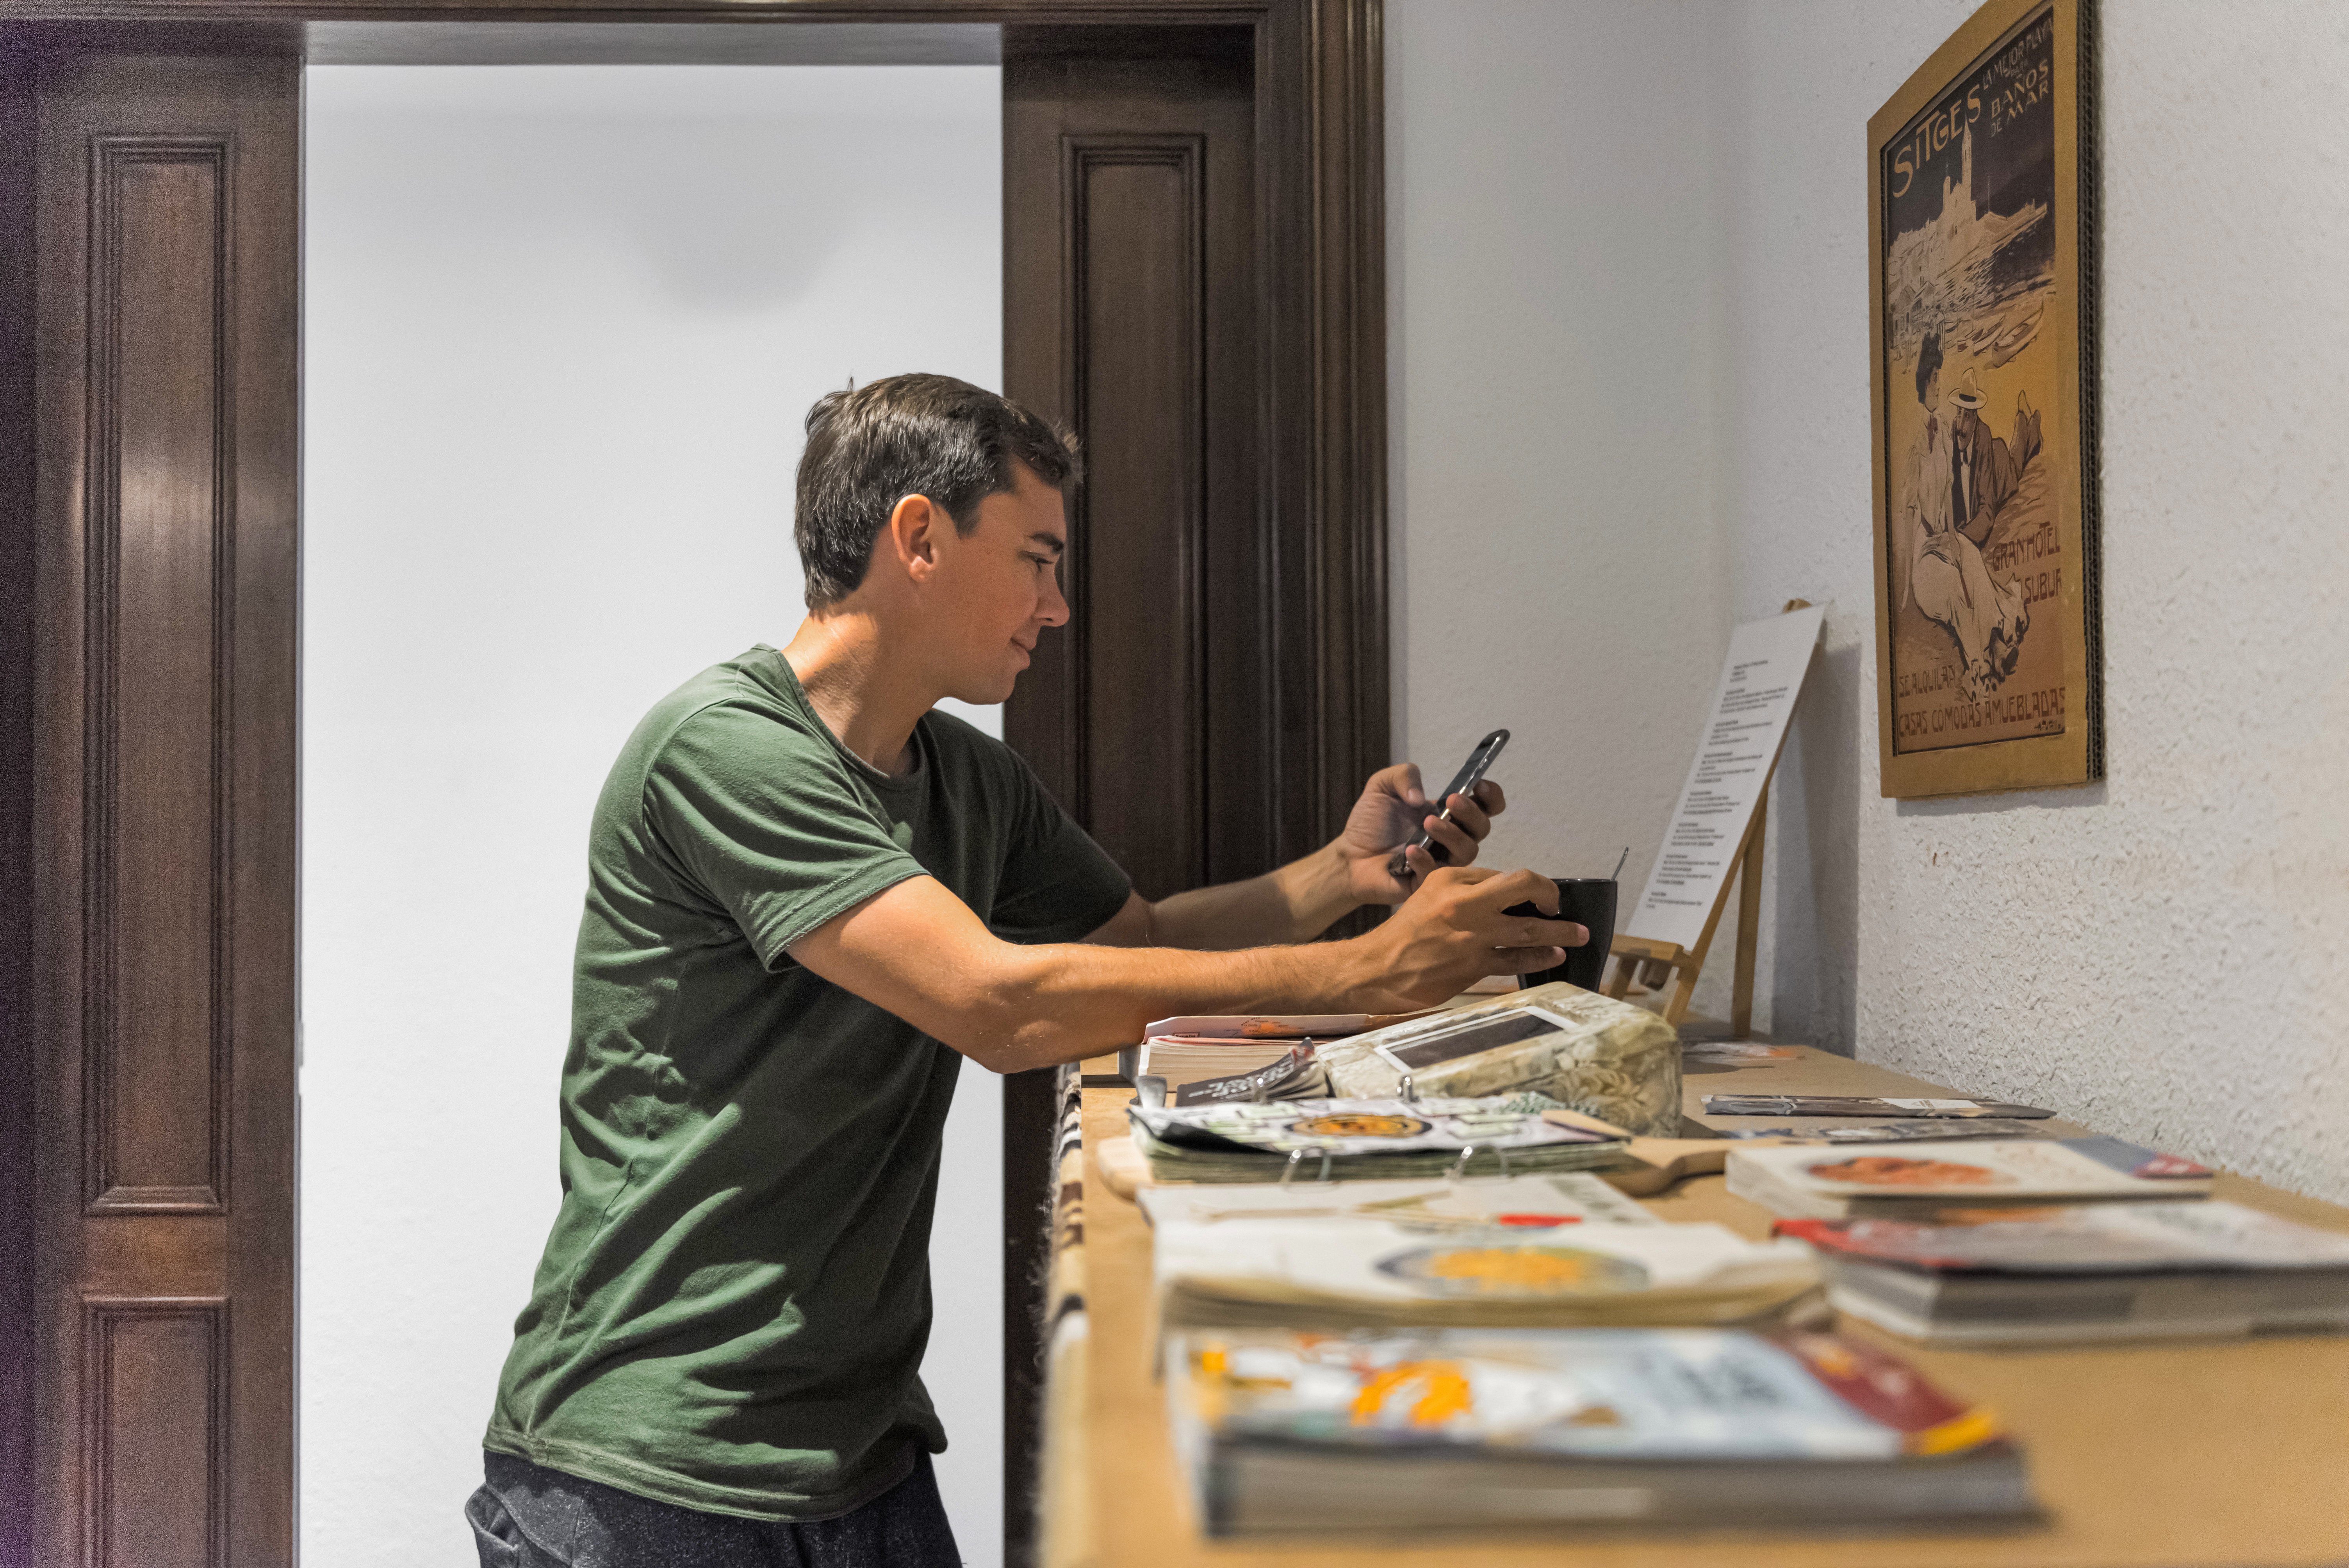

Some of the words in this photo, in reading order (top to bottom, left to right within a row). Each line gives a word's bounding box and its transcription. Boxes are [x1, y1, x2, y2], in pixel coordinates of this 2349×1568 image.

[1983, 69, 1992, 91] LA
[1993, 40, 2024, 81] MEJOR
[1991, 117, 2002, 137] DE
[2007, 79, 2049, 125] MAR
[1893, 83, 1980, 198] SITGES
[1993, 536, 2024, 572] GRAN
[2027, 521, 2061, 562] HOTEL
[1899, 675, 1911, 698] SE
[1899, 711, 1928, 738] CASAS
[1985, 687, 2066, 727] AMUEBLADAS
